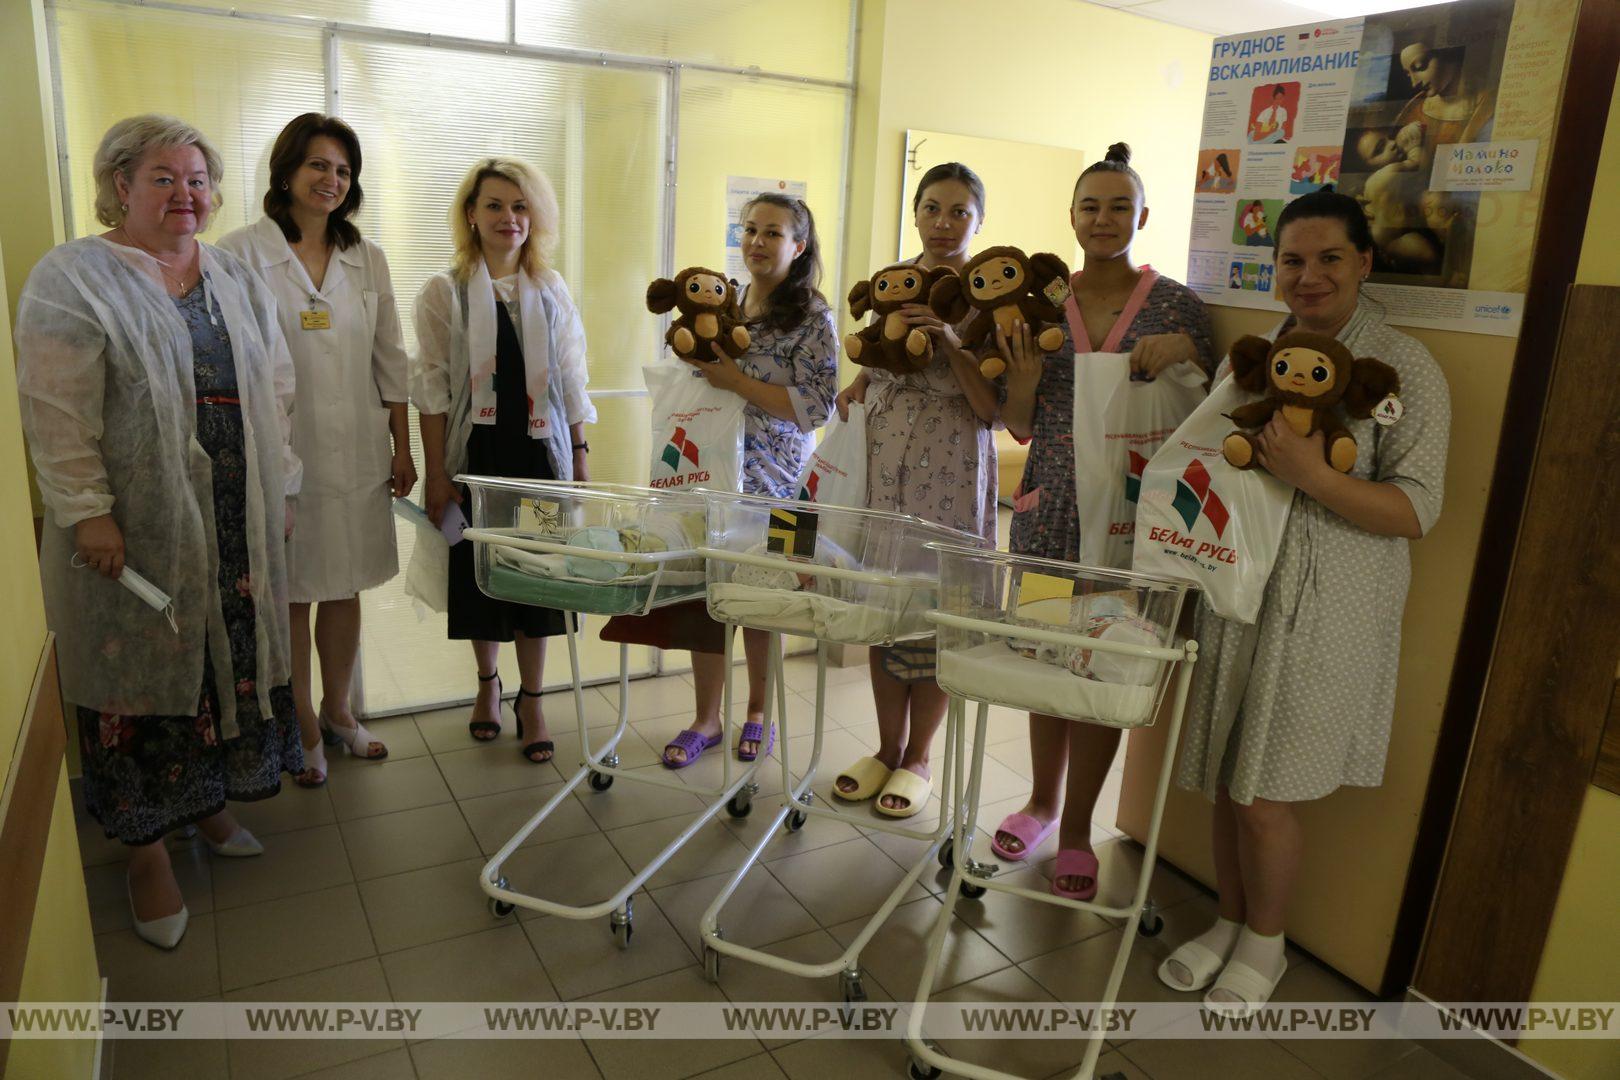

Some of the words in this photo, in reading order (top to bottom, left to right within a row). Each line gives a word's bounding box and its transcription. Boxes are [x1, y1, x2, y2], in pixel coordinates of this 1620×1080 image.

[1212, 35, 1286, 59] ГРУДНОЕ
[1210, 50, 1361, 81] ВСКАРМЛИВАНИЕ
[1475, 305, 1500, 313] unicef
[650, 475, 683, 488] БЕЛАЯ
[688, 470, 710, 484] РУСЬ
[1109, 521, 1135, 535] БЕЛ
[1196, 542, 1238, 564] РУСЬ
